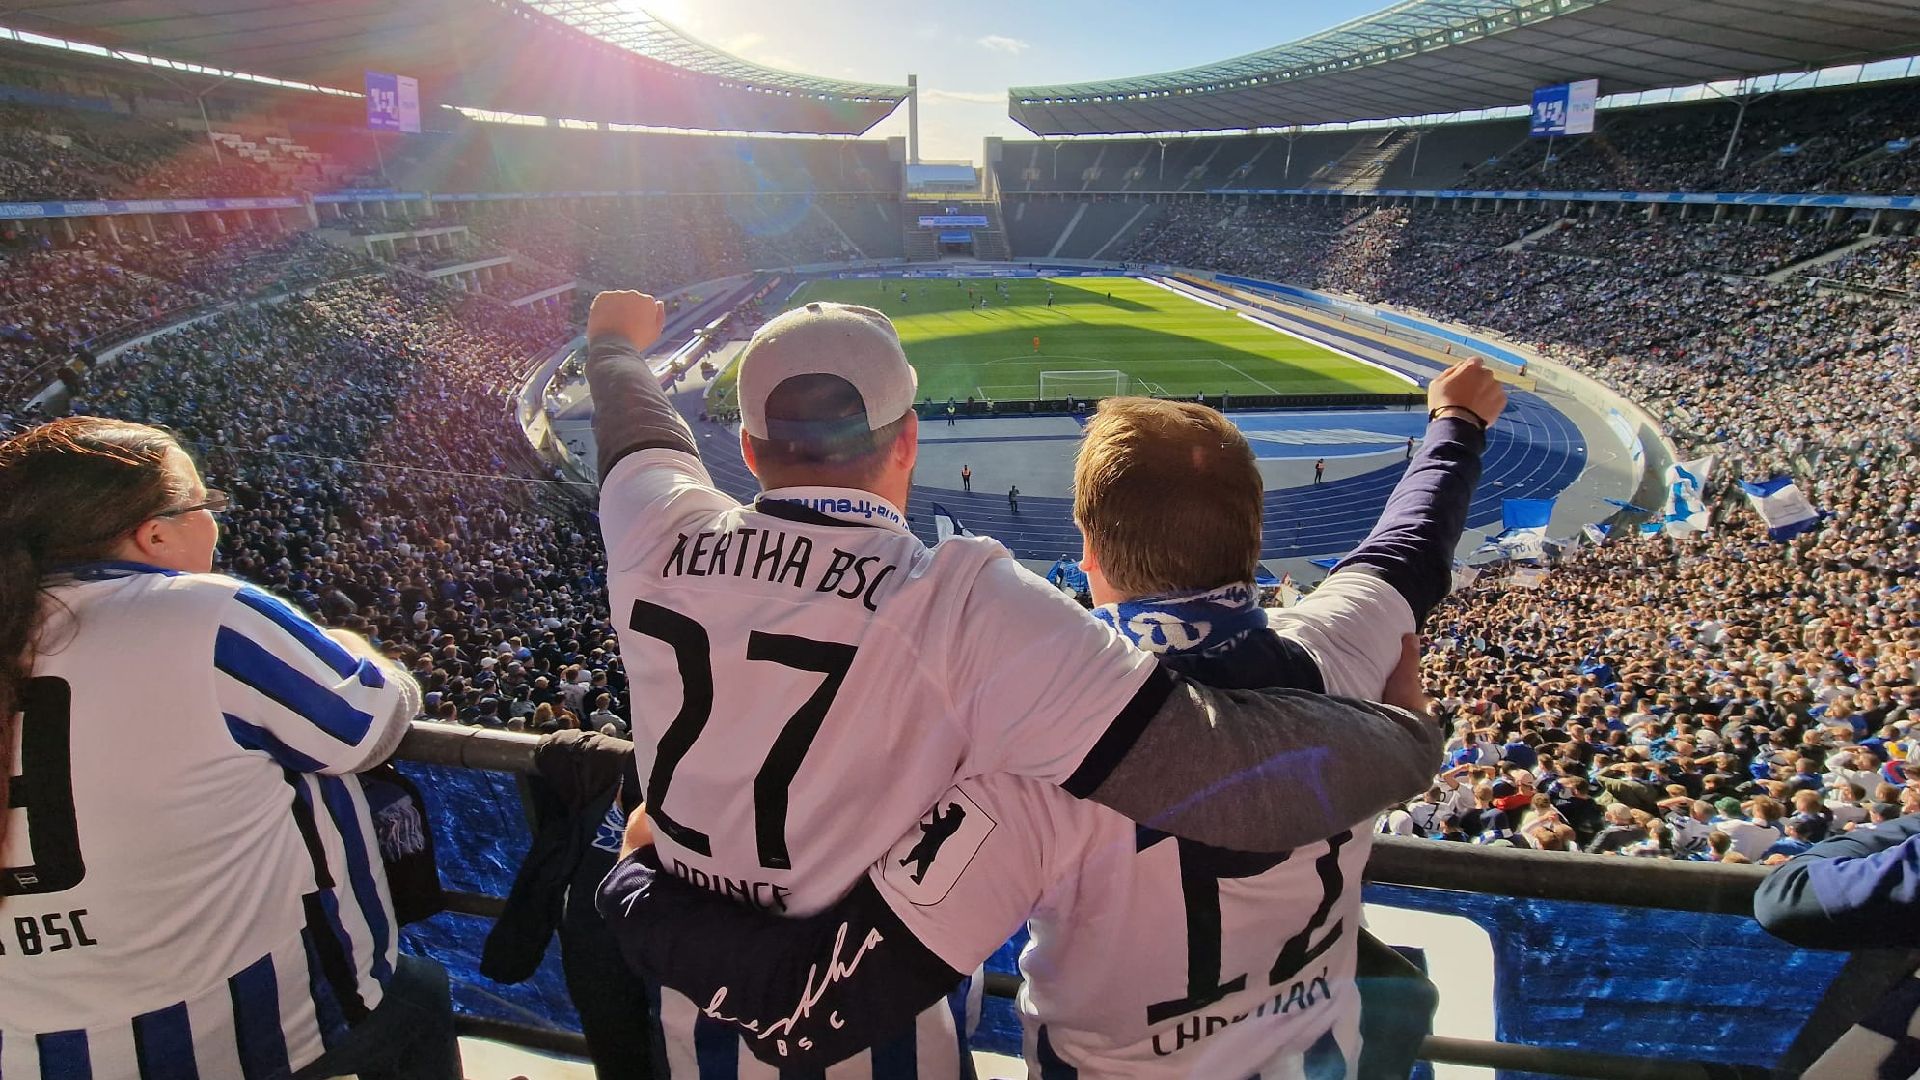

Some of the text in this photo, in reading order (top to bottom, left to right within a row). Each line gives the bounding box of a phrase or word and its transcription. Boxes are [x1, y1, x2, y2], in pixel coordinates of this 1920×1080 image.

[815, 548, 897, 612] BSC
[629, 599, 859, 869] 27
[14, 909, 98, 956] BSC
